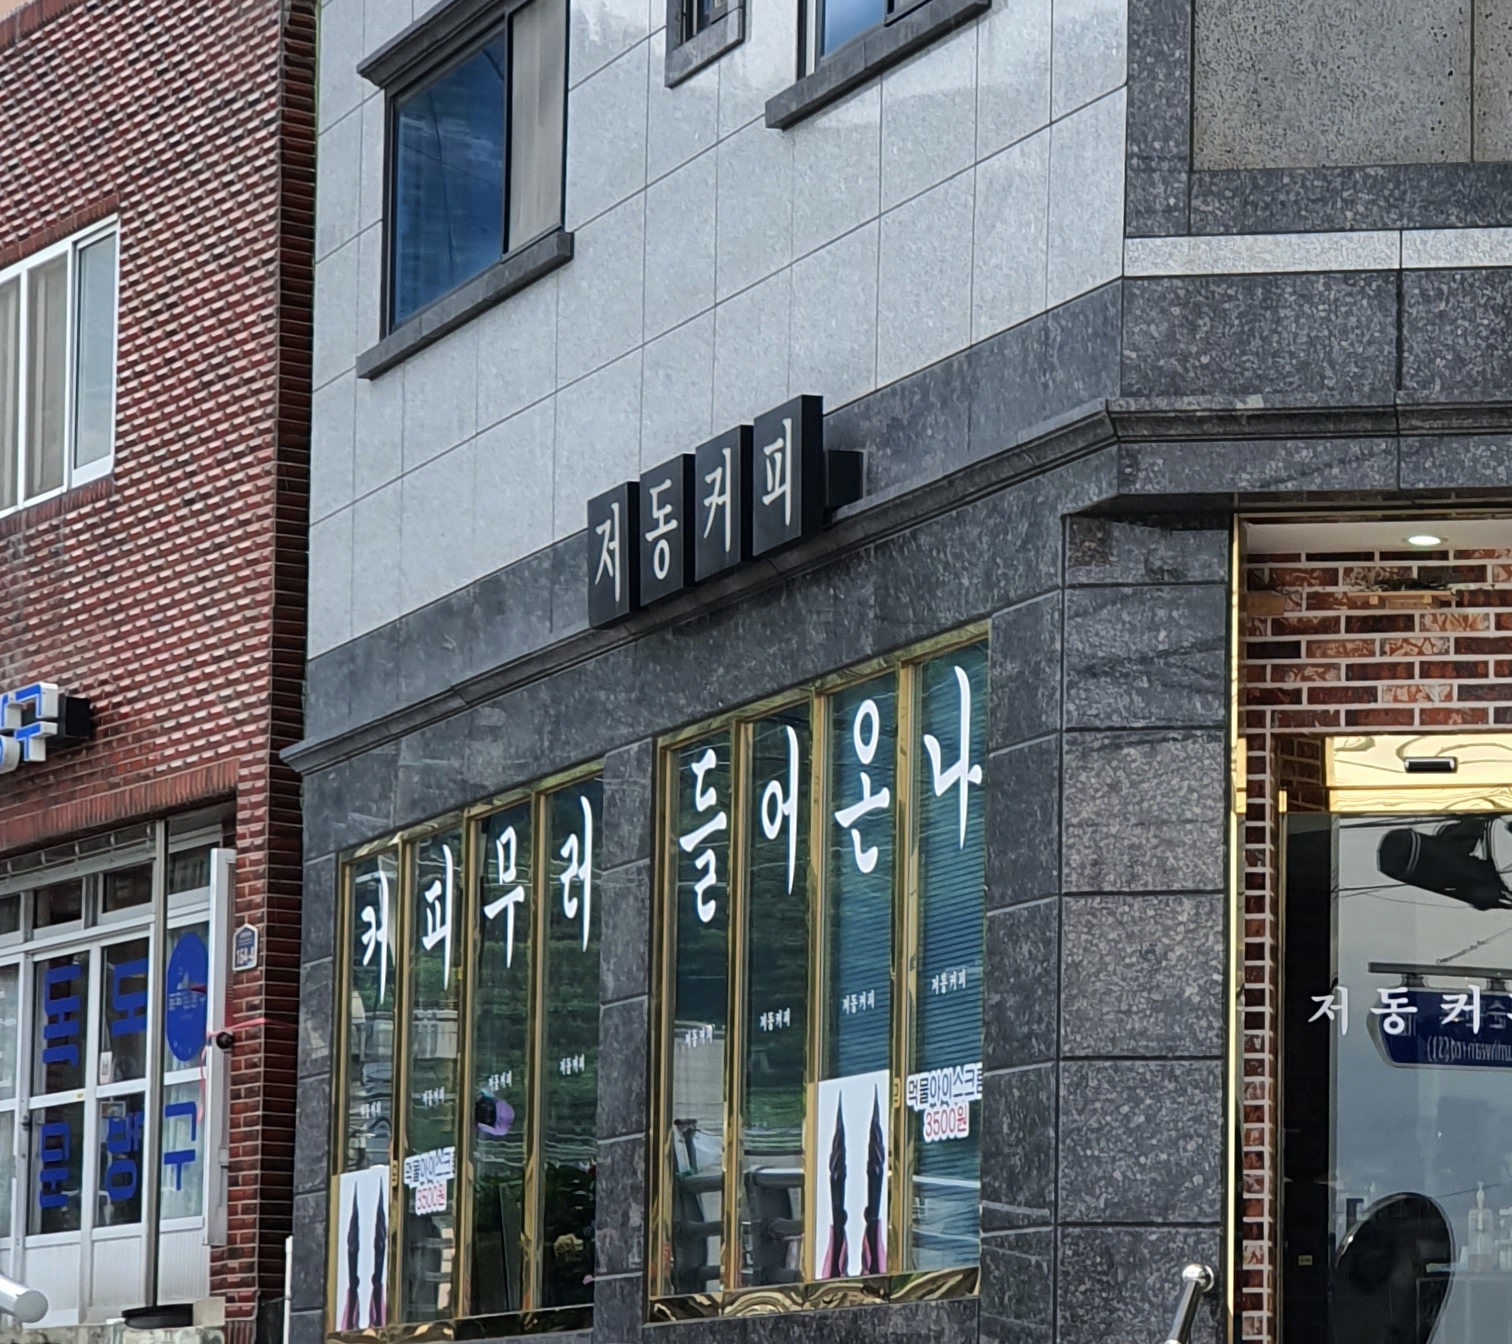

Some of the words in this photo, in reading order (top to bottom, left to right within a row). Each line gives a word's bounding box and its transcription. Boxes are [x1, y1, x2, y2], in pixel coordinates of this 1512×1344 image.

[595, 417, 792, 602] 저동커피
[0, 683, 52, 773] 구
[678, 665, 983, 923] 들어온나
[925, 1105, 967, 1138] 3500원
[405, 1151, 455, 1183] 먹물아이스크
